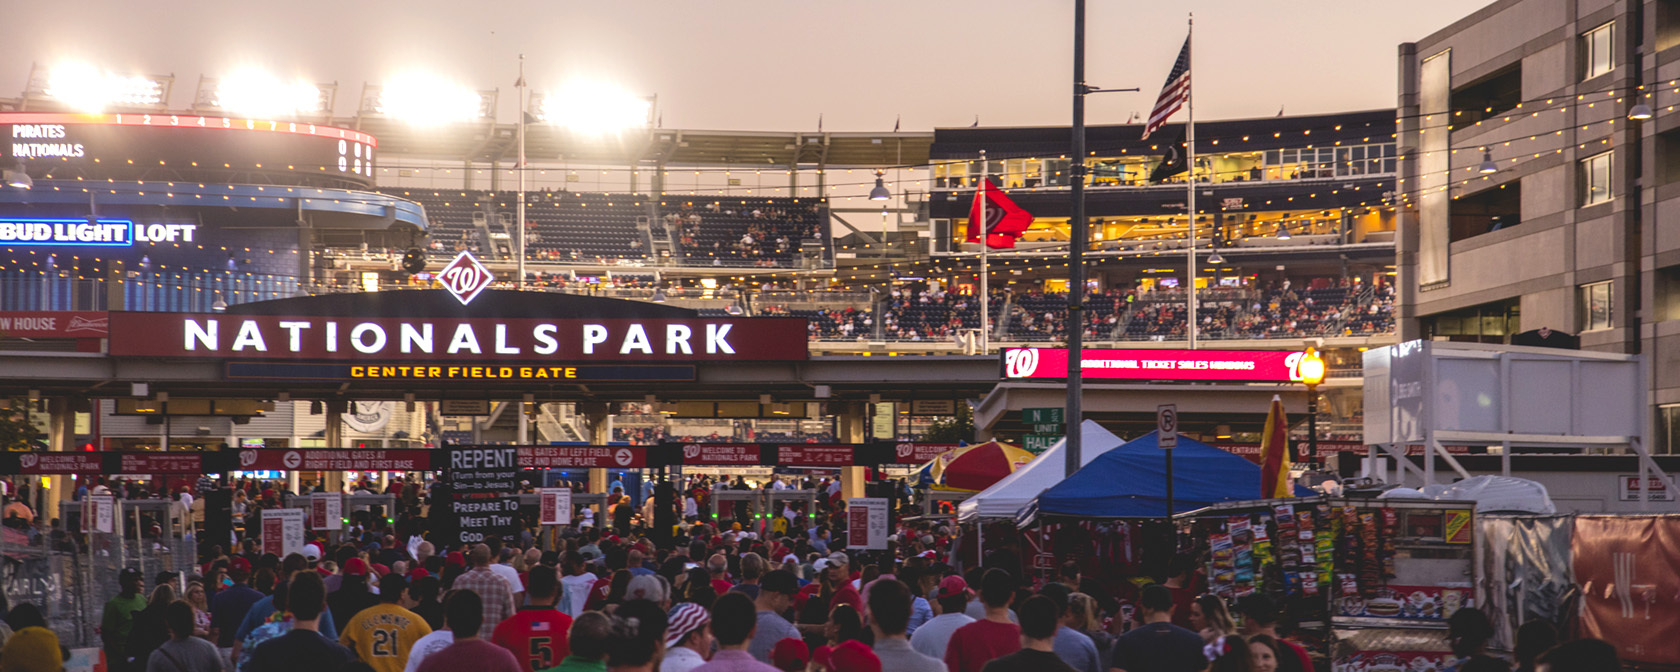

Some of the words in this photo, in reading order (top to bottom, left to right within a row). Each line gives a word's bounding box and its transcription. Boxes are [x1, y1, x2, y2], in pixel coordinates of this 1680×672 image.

[116, 114, 122, 124] 1
[143, 114, 151, 125] 2
[171, 115, 179, 126] 3
[198, 116, 205, 127] 4
[223, 117, 231, 128] 5
[247, 119, 254, 130] 6
[270, 120, 276, 131] 7
[289, 122, 296, 133] 8
[309, 124, 315, 134] 9
[12, 124, 66, 139] PIRATES
[12, 143, 85, 157] NATIONALS
[0, 223, 52, 241] BUD
[54, 223, 128, 242] LIGHT
[135, 224, 197, 242] LOFT
[14, 317, 56, 331] HOUSE
[184, 318, 559, 355] NATIONALS
[582, 323, 737, 355] PARK
[350, 366, 442, 378] CENTER
[448, 366, 513, 378] FIELD
[520, 367, 577, 378] GATE
[1032, 410, 1041, 422] N
[1034, 423, 1058, 433] UNIT
[305, 451, 350, 460] ADDITIONAL
[352, 451, 375, 459] GATES
[377, 451, 386, 459] AT
[535, 448, 558, 457] GATES
[559, 448, 569, 457] AT
[570, 448, 586, 457] LEFT
[588, 448, 612, 458] FIELD,
[1232, 446, 1261, 454] ENTRAN
[451, 448, 515, 469] REPENT
[535, 457, 550, 466] AND
[552, 457, 572, 466] HOME
[574, 457, 597, 466] PLATE
[702, 454, 738, 462] NATIONALS
[739, 454, 758, 462] PARK
[305, 460, 327, 469] RIGHT
[329, 460, 352, 469] FIELD
[354, 460, 369, 469] AND
[371, 460, 393, 469] FIRST
[394, 460, 413, 469] BASE
[475, 471, 495, 479] from
[496, 472, 516, 480] your
[453, 501, 501, 513] PREPARE
[460, 516, 488, 528] MEET
[490, 515, 512, 526] THY
[372, 628, 399, 657] 21
[528, 636, 553, 671] 5
